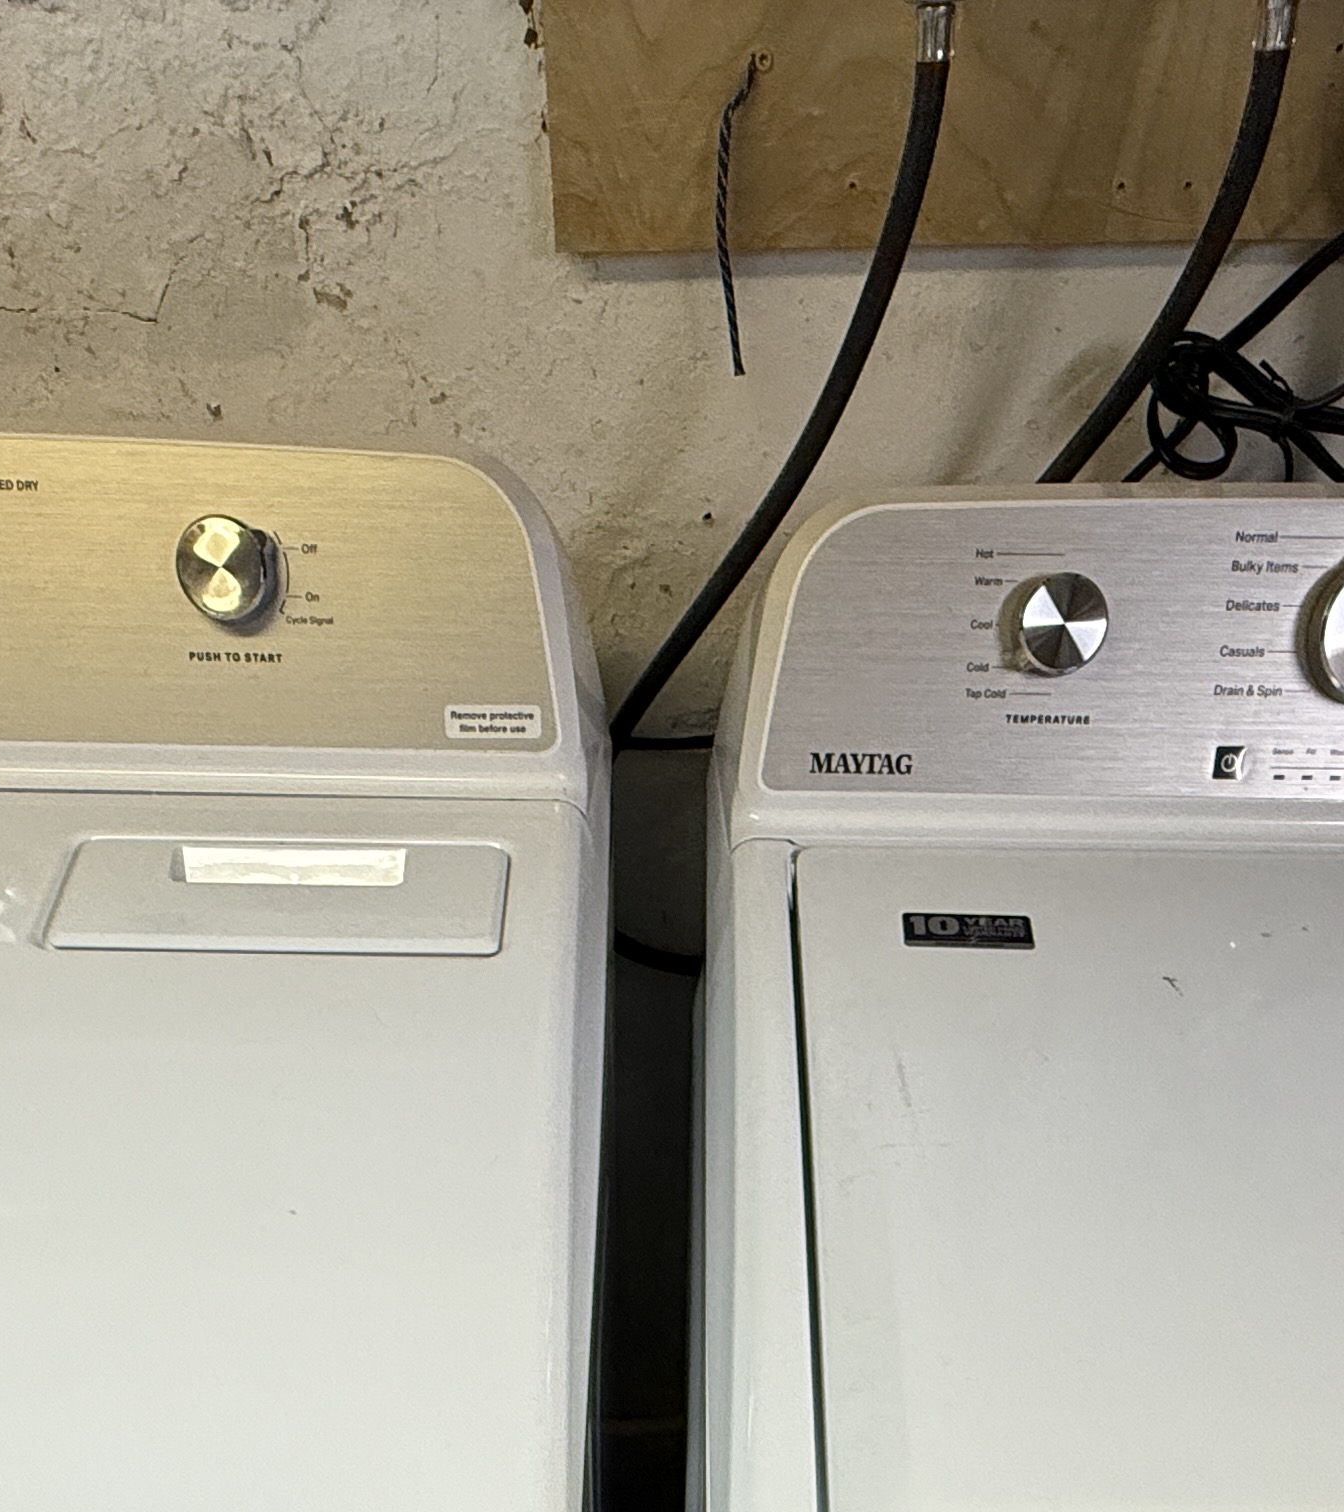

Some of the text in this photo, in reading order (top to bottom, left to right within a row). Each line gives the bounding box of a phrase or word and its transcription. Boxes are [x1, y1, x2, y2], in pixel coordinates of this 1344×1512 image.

[15, 480, 39, 492] DRY
[1235, 531, 1279, 544] Normal
[300, 543, 318, 555] Off
[975, 548, 994, 559] Hot
[1231, 561, 1299, 575] Bulky Items
[975, 576, 1003, 586] Warm
[305, 592, 320, 603] On
[1225, 599, 1280, 613] Delicates
[970, 618, 994, 631] Cool
[189, 651, 283, 664] PUSH TO START
[1219, 645, 1266, 658] Casuals
[966, 661, 990, 673] Cold
[965, 688, 1007, 701] Tap Cold
[1213, 684, 1283, 699] Drain & Spin
[450, 711, 535, 721] Remove protective
[1005, 714, 1091, 726] TEMPERATURE
[459, 724, 477, 733] film
[478, 724, 508, 733] before
[809, 752, 914, 775] MAYTAG
[909, 915, 960, 936] 10
